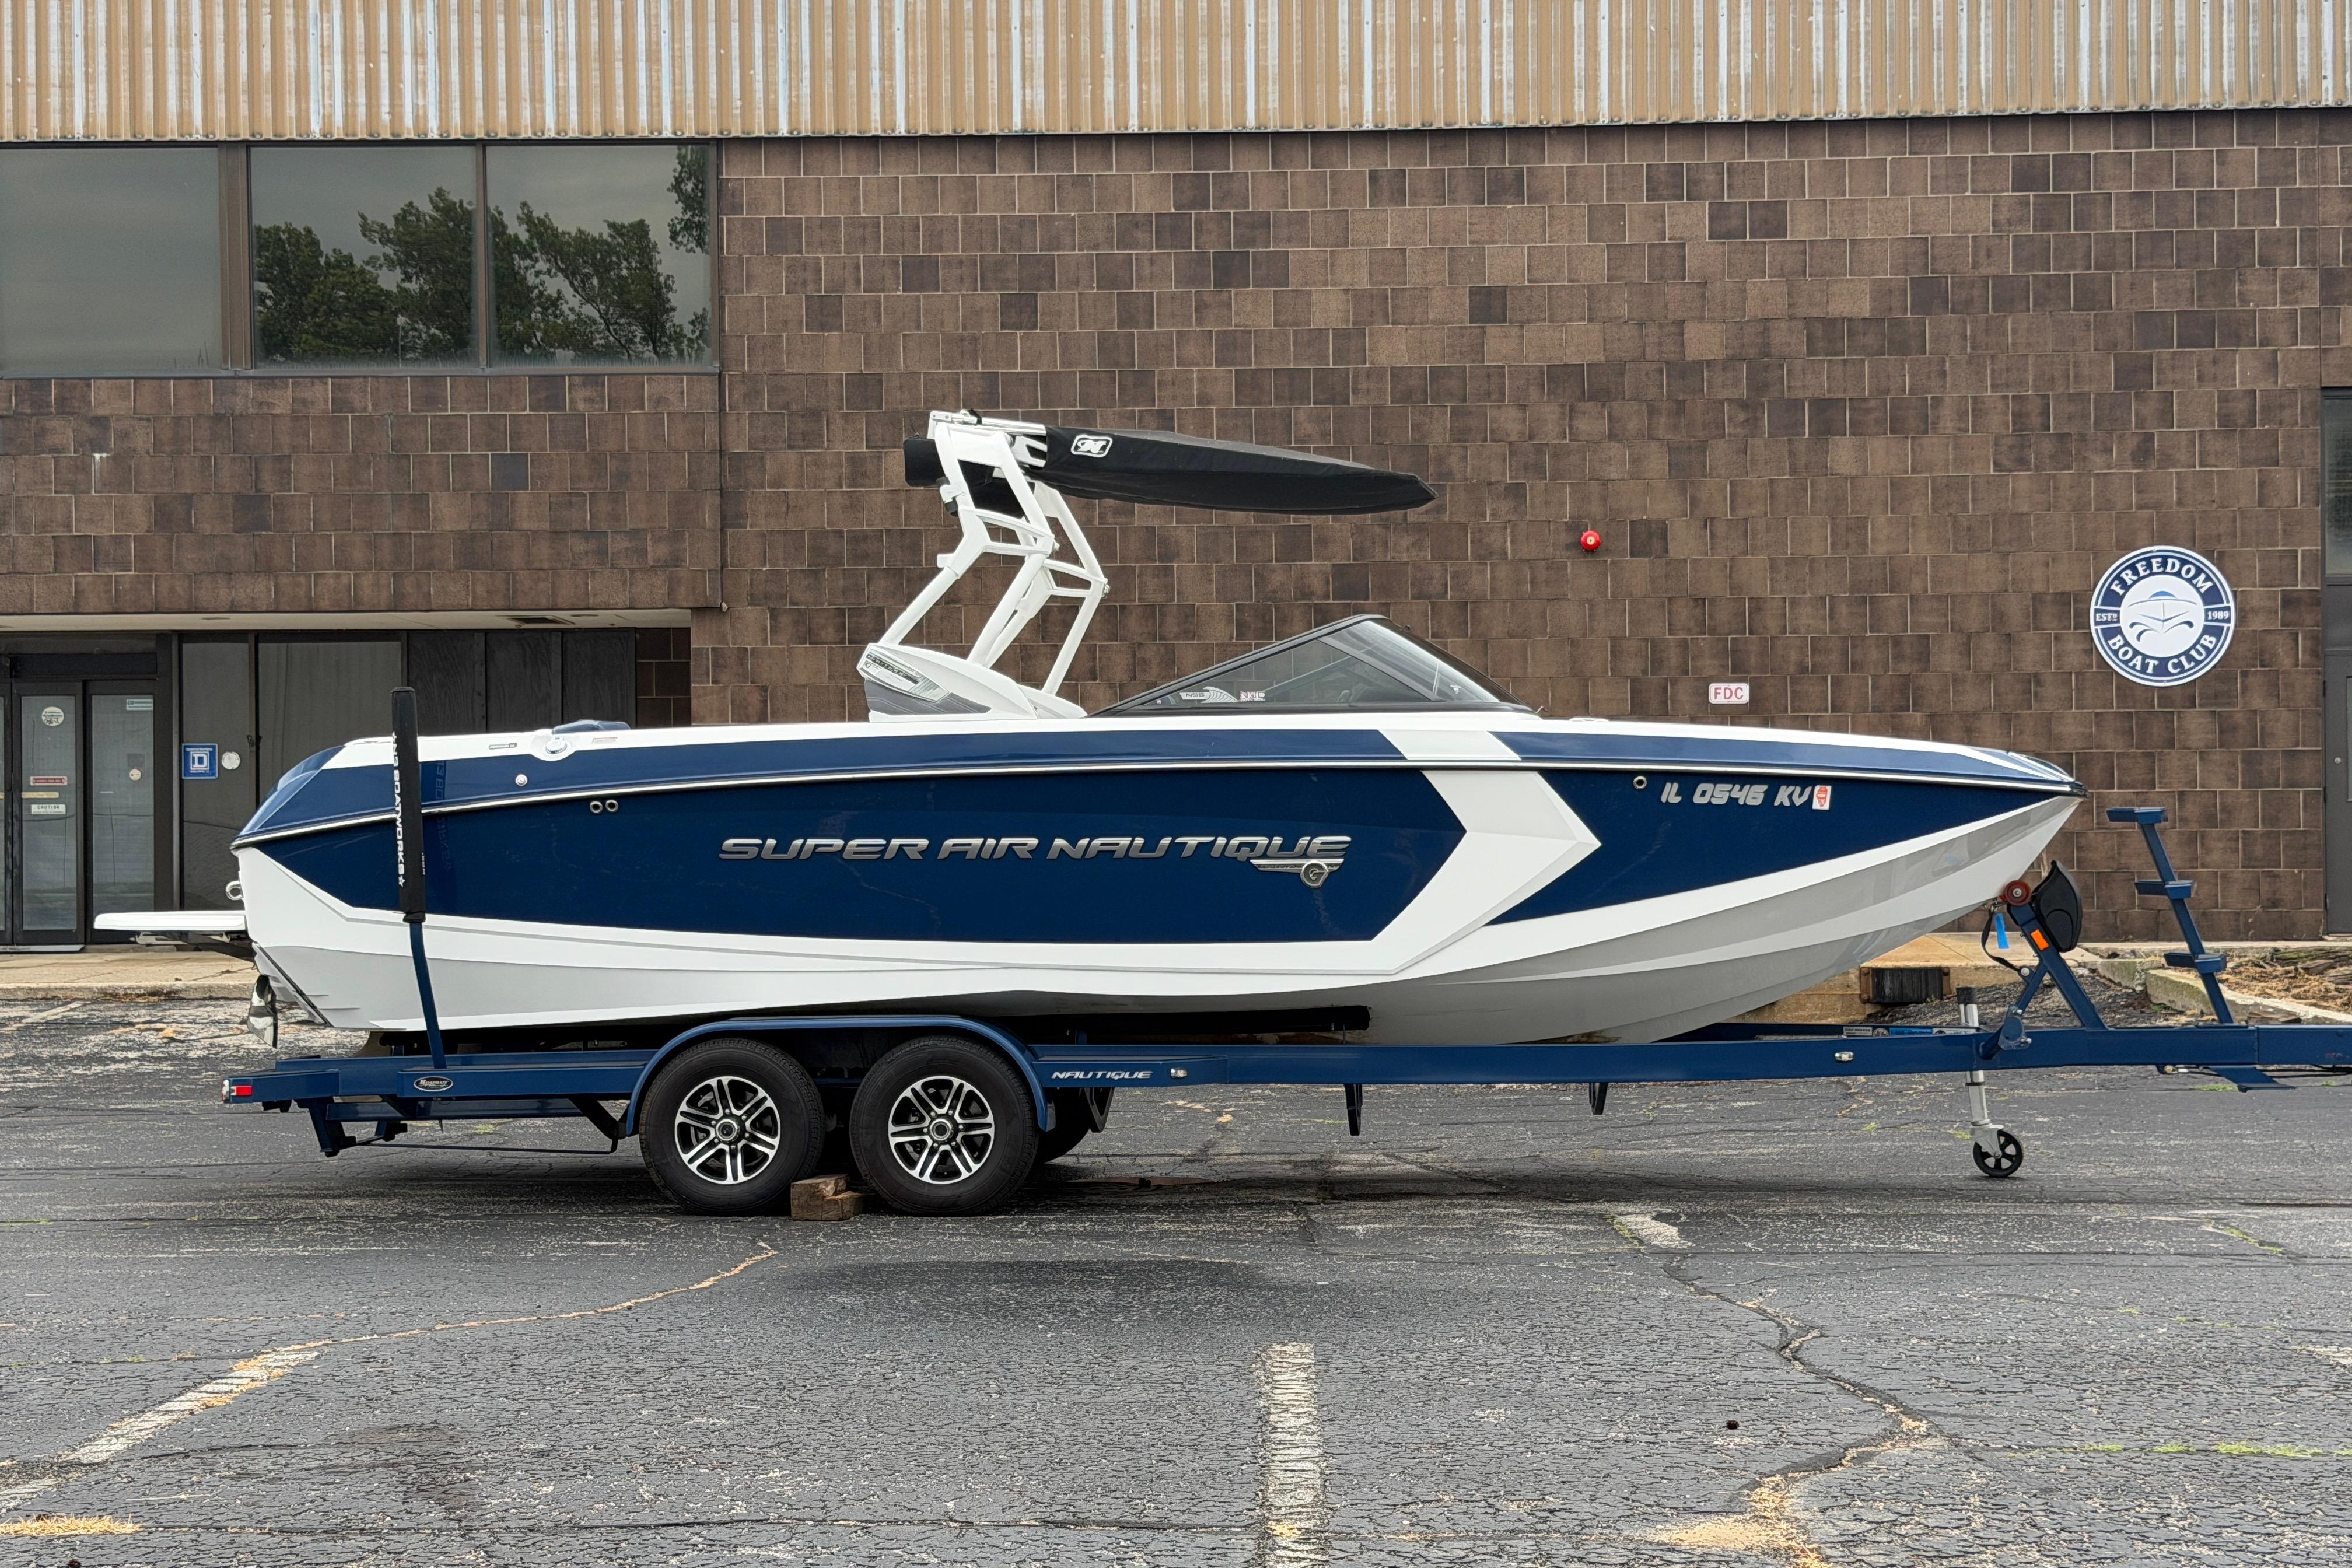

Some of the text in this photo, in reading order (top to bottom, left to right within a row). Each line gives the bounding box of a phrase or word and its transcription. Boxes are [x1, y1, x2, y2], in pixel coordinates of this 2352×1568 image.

[2110, 558, 2214, 596] FREEDOM
[2207, 611, 2230, 620] 1989
[2108, 634, 2217, 674] BOAT CLUB
[1714, 687, 1744, 700] FDC
[1660, 782, 1812, 807] IL 0546 KV
[393, 769, 405, 875] BOATWORKS
[719, 836, 1352, 862] SUPER AIR NAUTIQUE
[1051, 1071, 1153, 1080] NAUTIQUE
